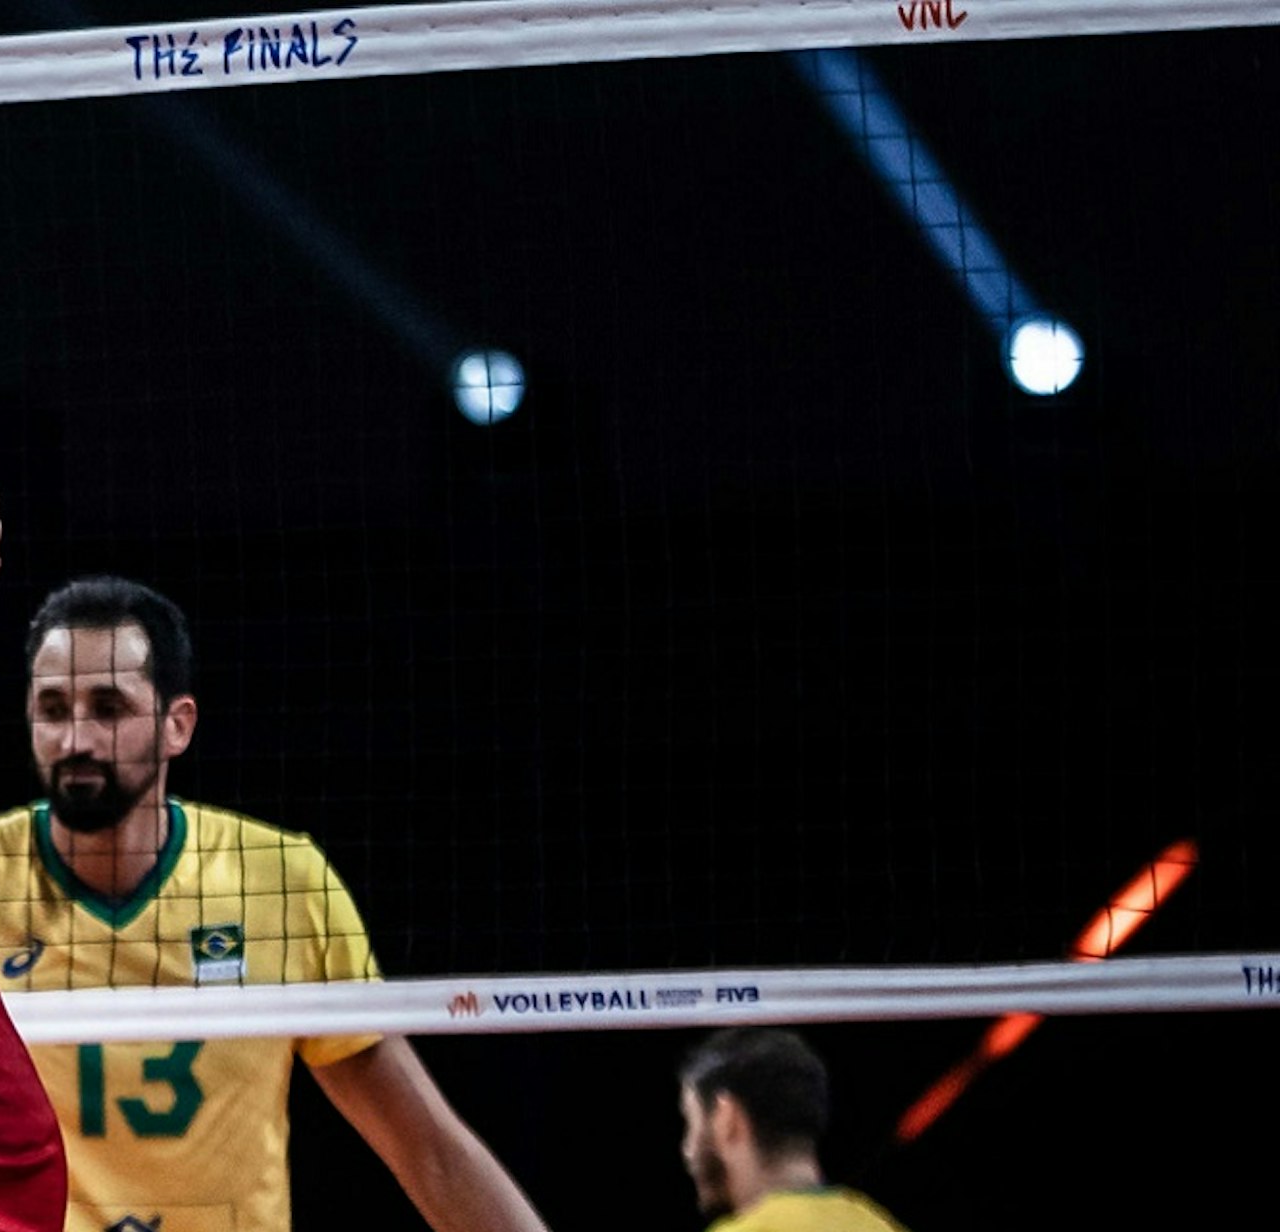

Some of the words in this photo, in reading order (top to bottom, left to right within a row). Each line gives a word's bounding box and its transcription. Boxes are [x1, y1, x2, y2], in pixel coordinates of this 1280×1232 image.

[126, 32, 203, 80] THE
[224, 18, 359, 74] FINALS
[493, 989, 652, 1014] VOLLEYBALL
[1242, 965, 1280, 996] TH
[77, 1038, 205, 1139] 13
